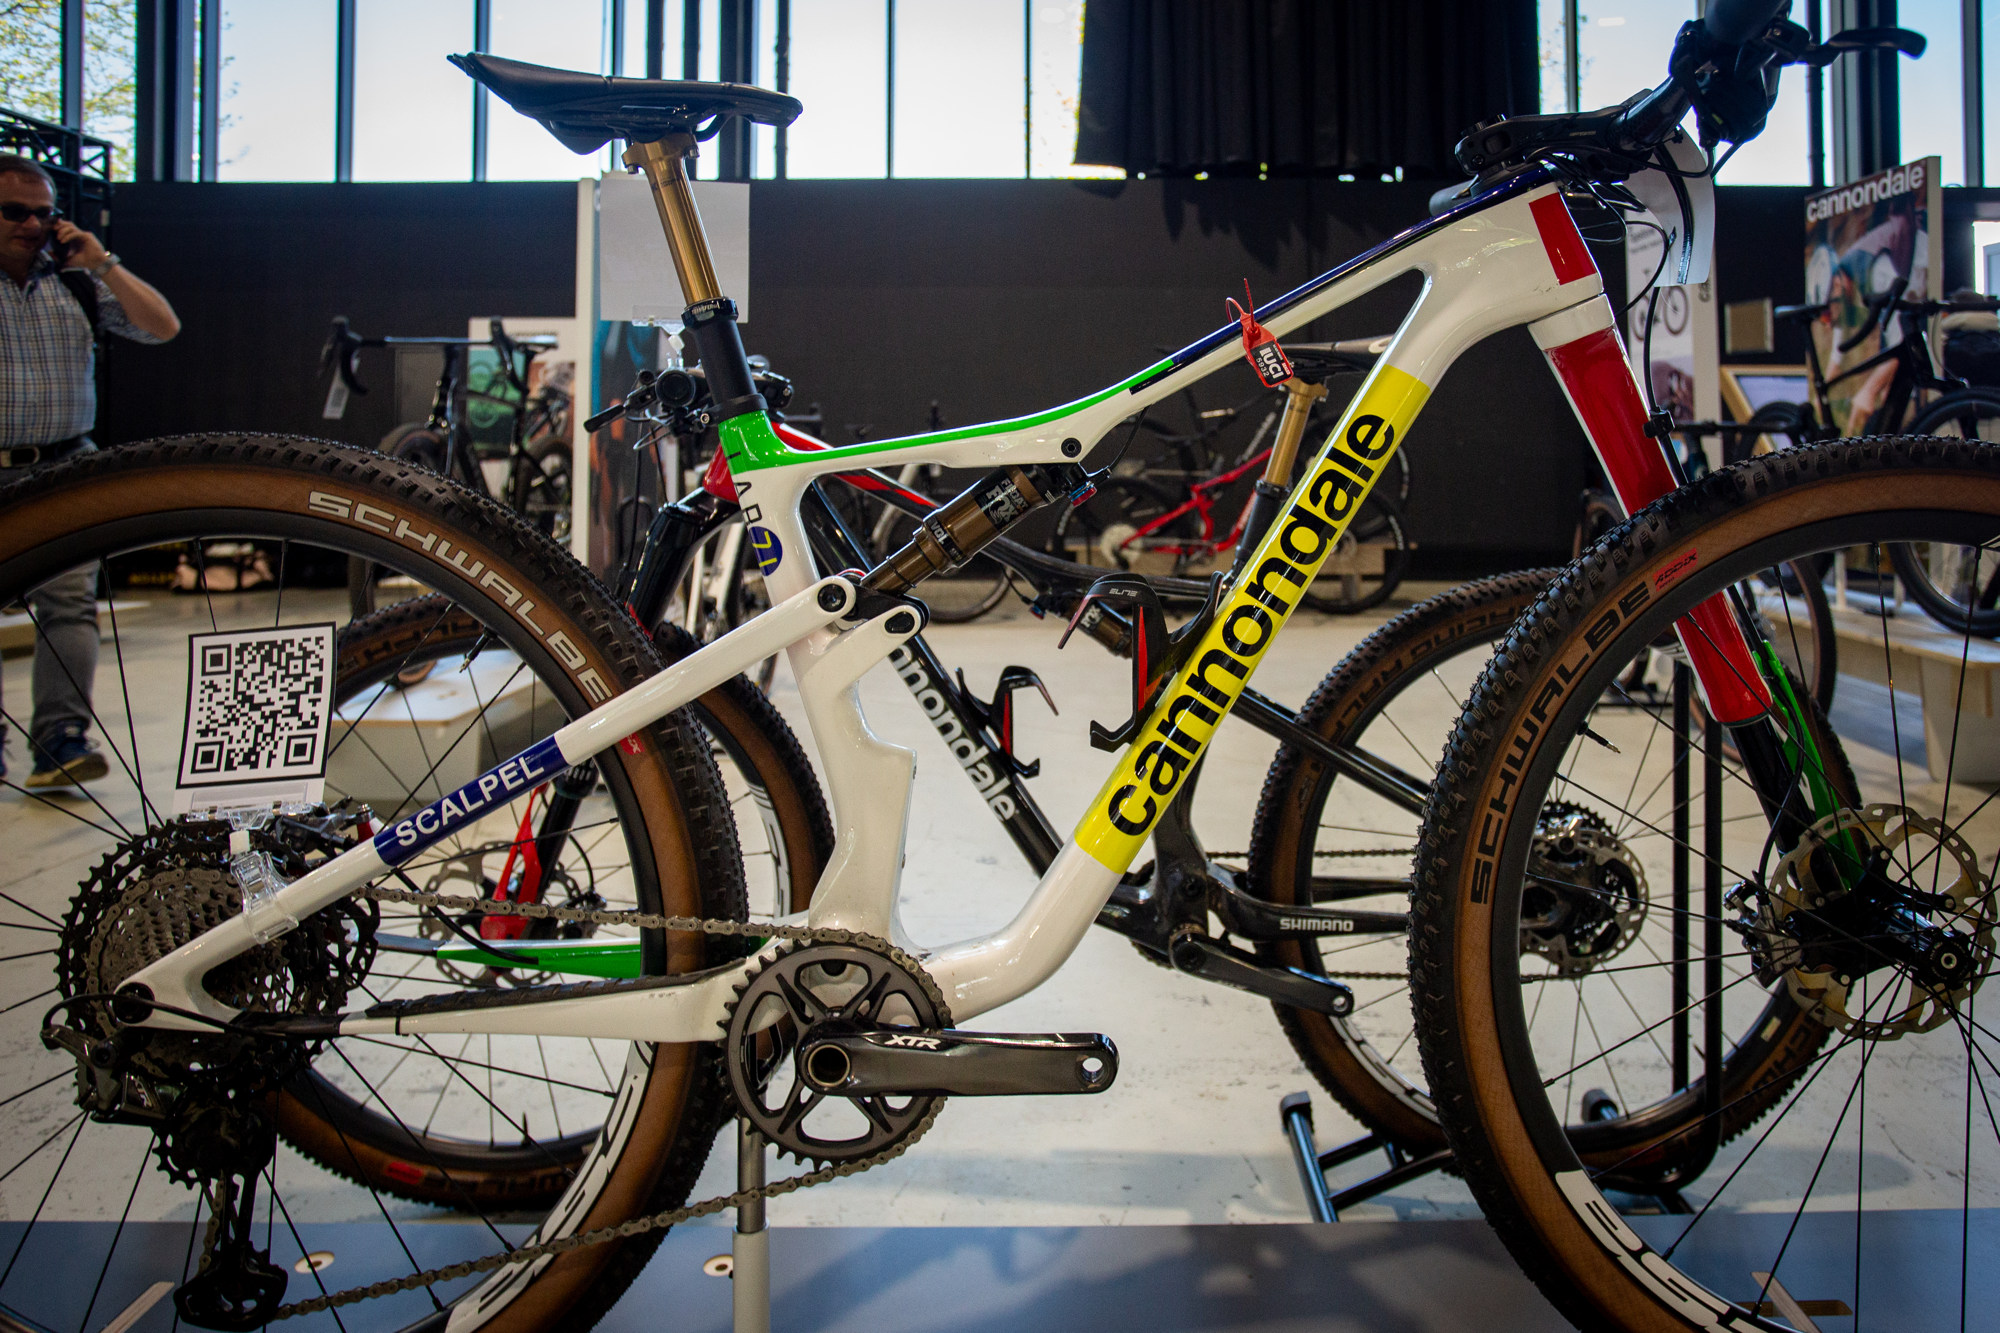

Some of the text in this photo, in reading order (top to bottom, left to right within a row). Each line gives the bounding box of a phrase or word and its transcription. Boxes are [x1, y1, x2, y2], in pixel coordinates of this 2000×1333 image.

[1806, 165, 1924, 223] cannondale
[985, 485, 1021, 523] FOX
[1001, 477, 1029, 511] FLOAT
[308, 490, 613, 704] SCHWALBE
[1108, 587, 1139, 599] ELITE
[1108, 413, 1396, 837] cannondale
[1470, 581, 1651, 905] SCHWALBE
[394, 753, 545, 848] SCALPEL
[1280, 917, 1355, 933] SHIMANO
[884, 1033, 943, 1051] XTR
